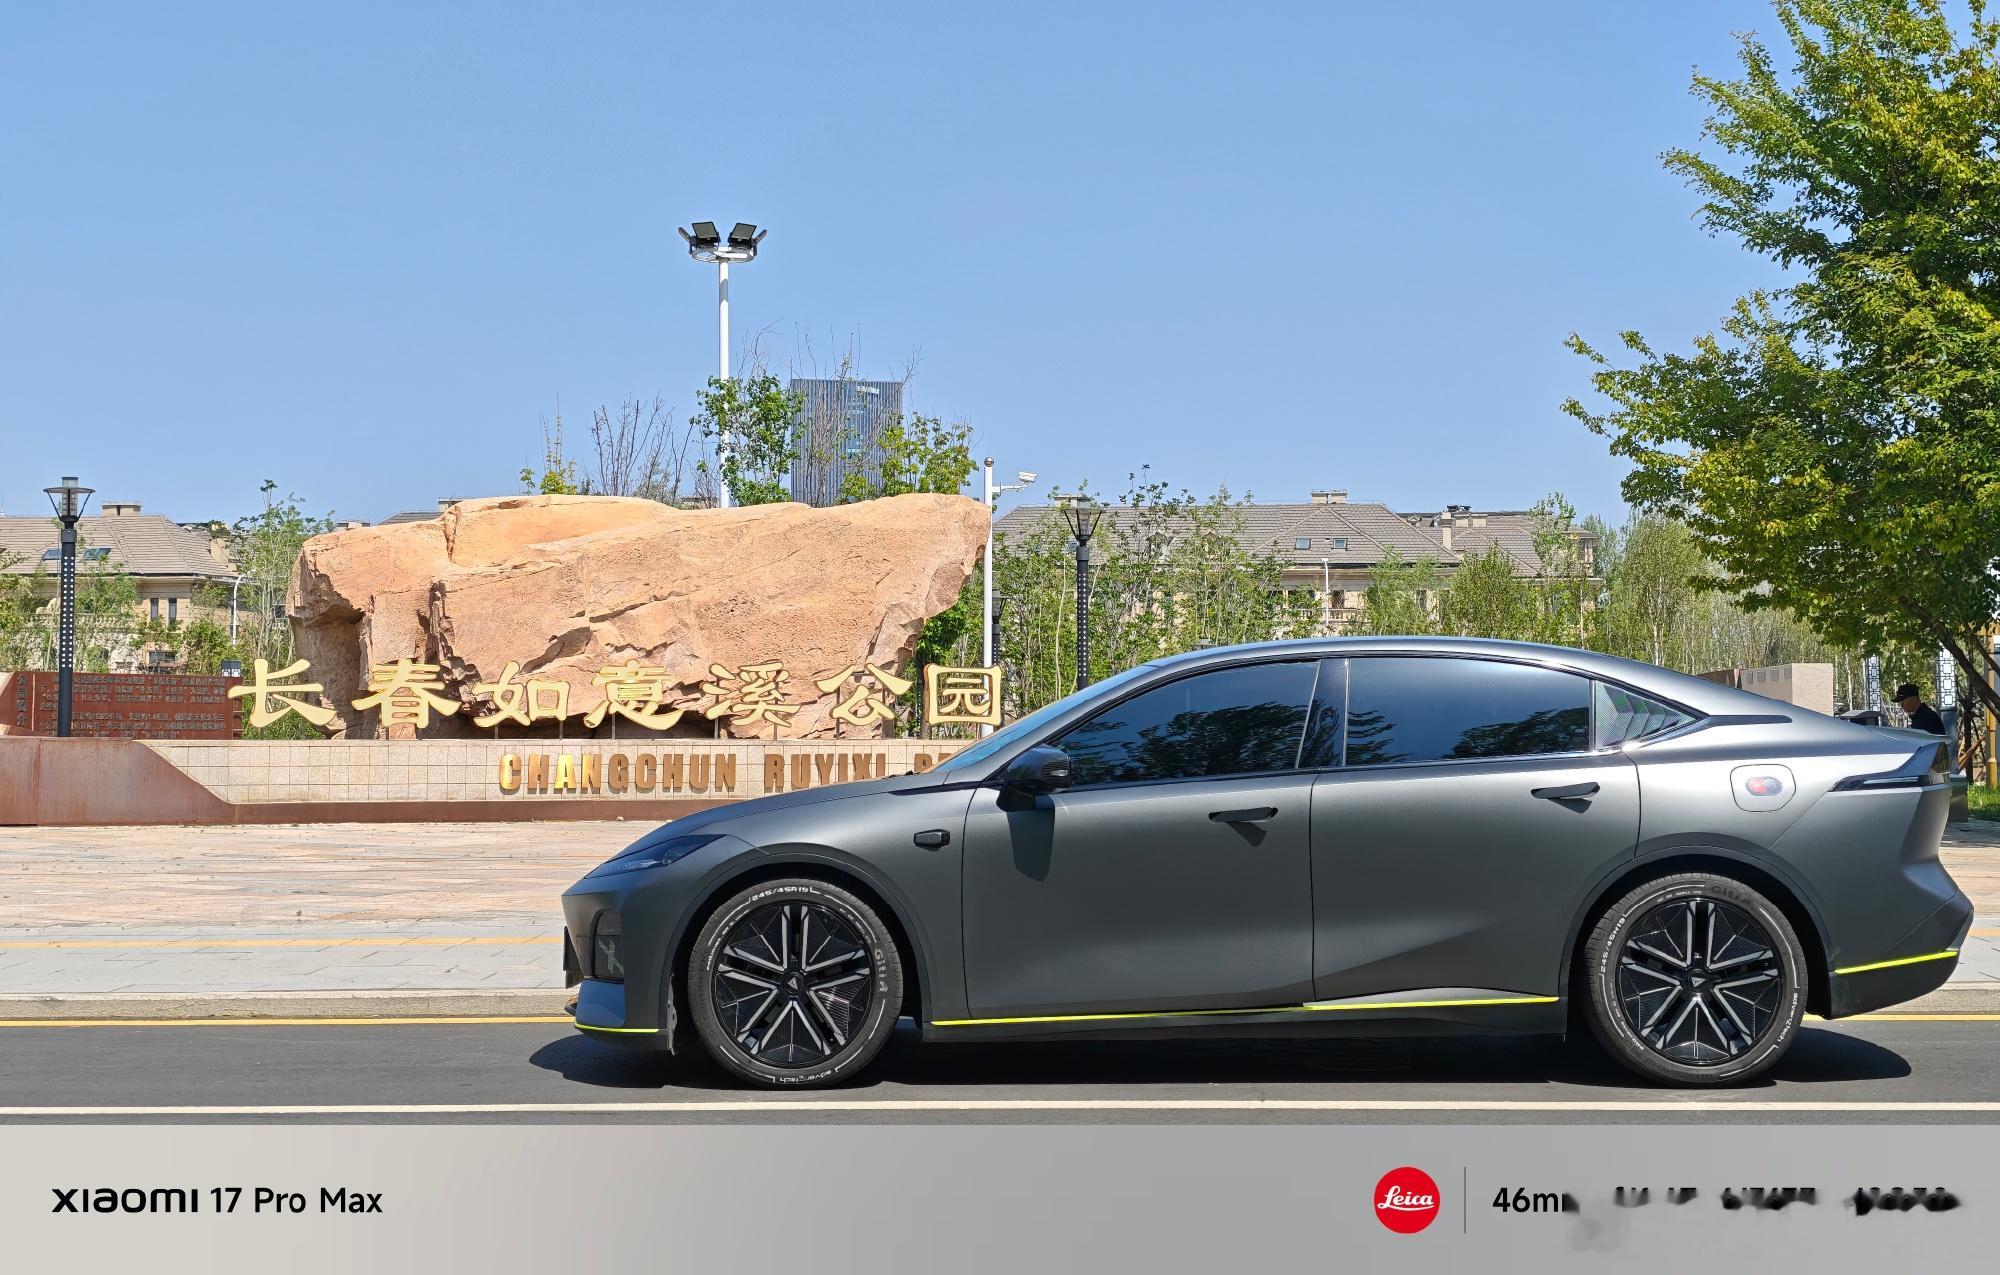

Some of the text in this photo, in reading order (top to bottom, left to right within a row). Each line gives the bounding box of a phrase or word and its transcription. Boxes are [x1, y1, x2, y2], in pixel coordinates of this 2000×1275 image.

[228, 658, 1002, 728] 长春如意溪公园
[499, 753, 736, 793] CHANGCHUN
[764, 753, 887, 791] RUYIXI
